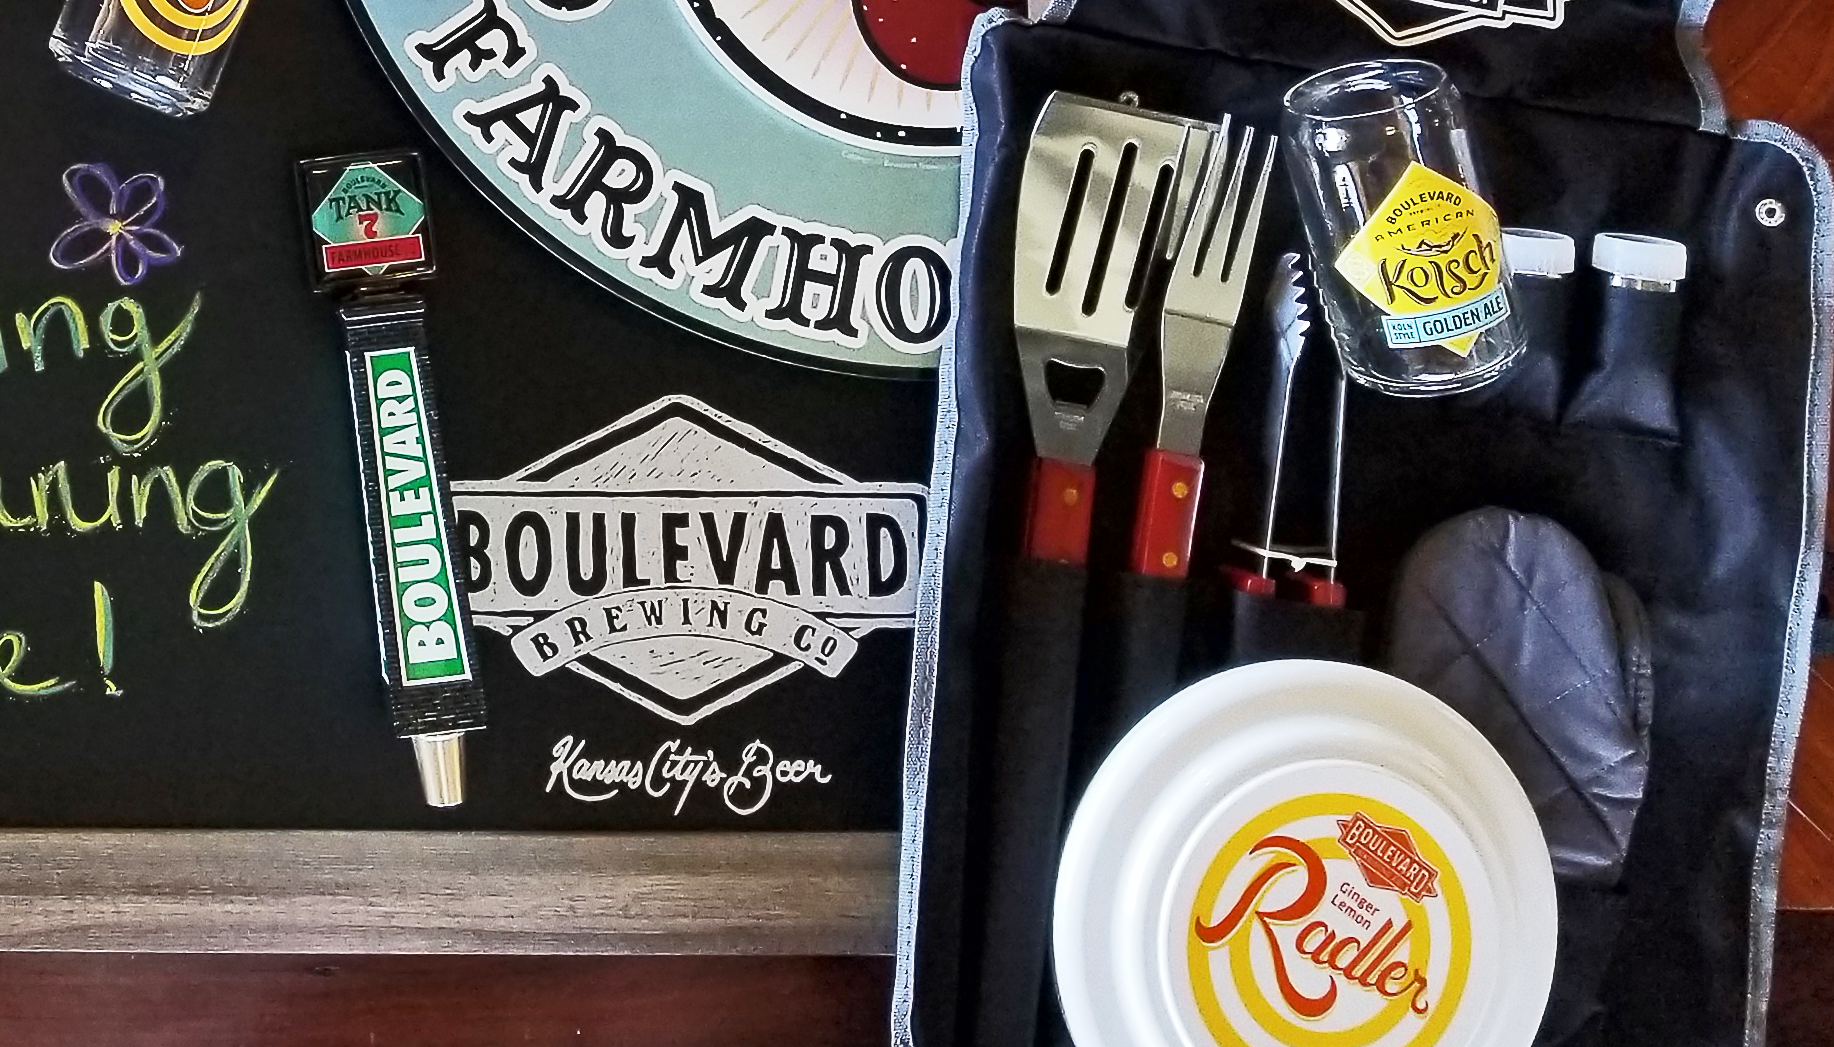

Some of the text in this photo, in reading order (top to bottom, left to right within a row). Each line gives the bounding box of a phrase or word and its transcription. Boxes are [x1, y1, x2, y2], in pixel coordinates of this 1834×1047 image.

[328, 189, 406, 223] TANK
[358, 213, 379, 240] 7
[1374, 209, 1475, 243] AMERICAN
[1386, 191, 1463, 226] BOULEVARD
[330, 243, 402, 265] FARMHOUSE
[1377, 233, 1497, 306] Kolsch
[1422, 295, 1504, 337] GOLDEN ALE
[375, 366, 459, 668] BOULEVARD
[456, 509, 907, 599] BOULEVARD
[528, 599, 769, 662] BREWING
[544, 735, 833, 816] Kansas City's Beer
[1346, 817, 1430, 893] BOULEVARD
[1330, 893, 1373, 931] Lemon
[1340, 881, 1381, 916] Ginger
[1194, 835, 1430, 1019] Radler
